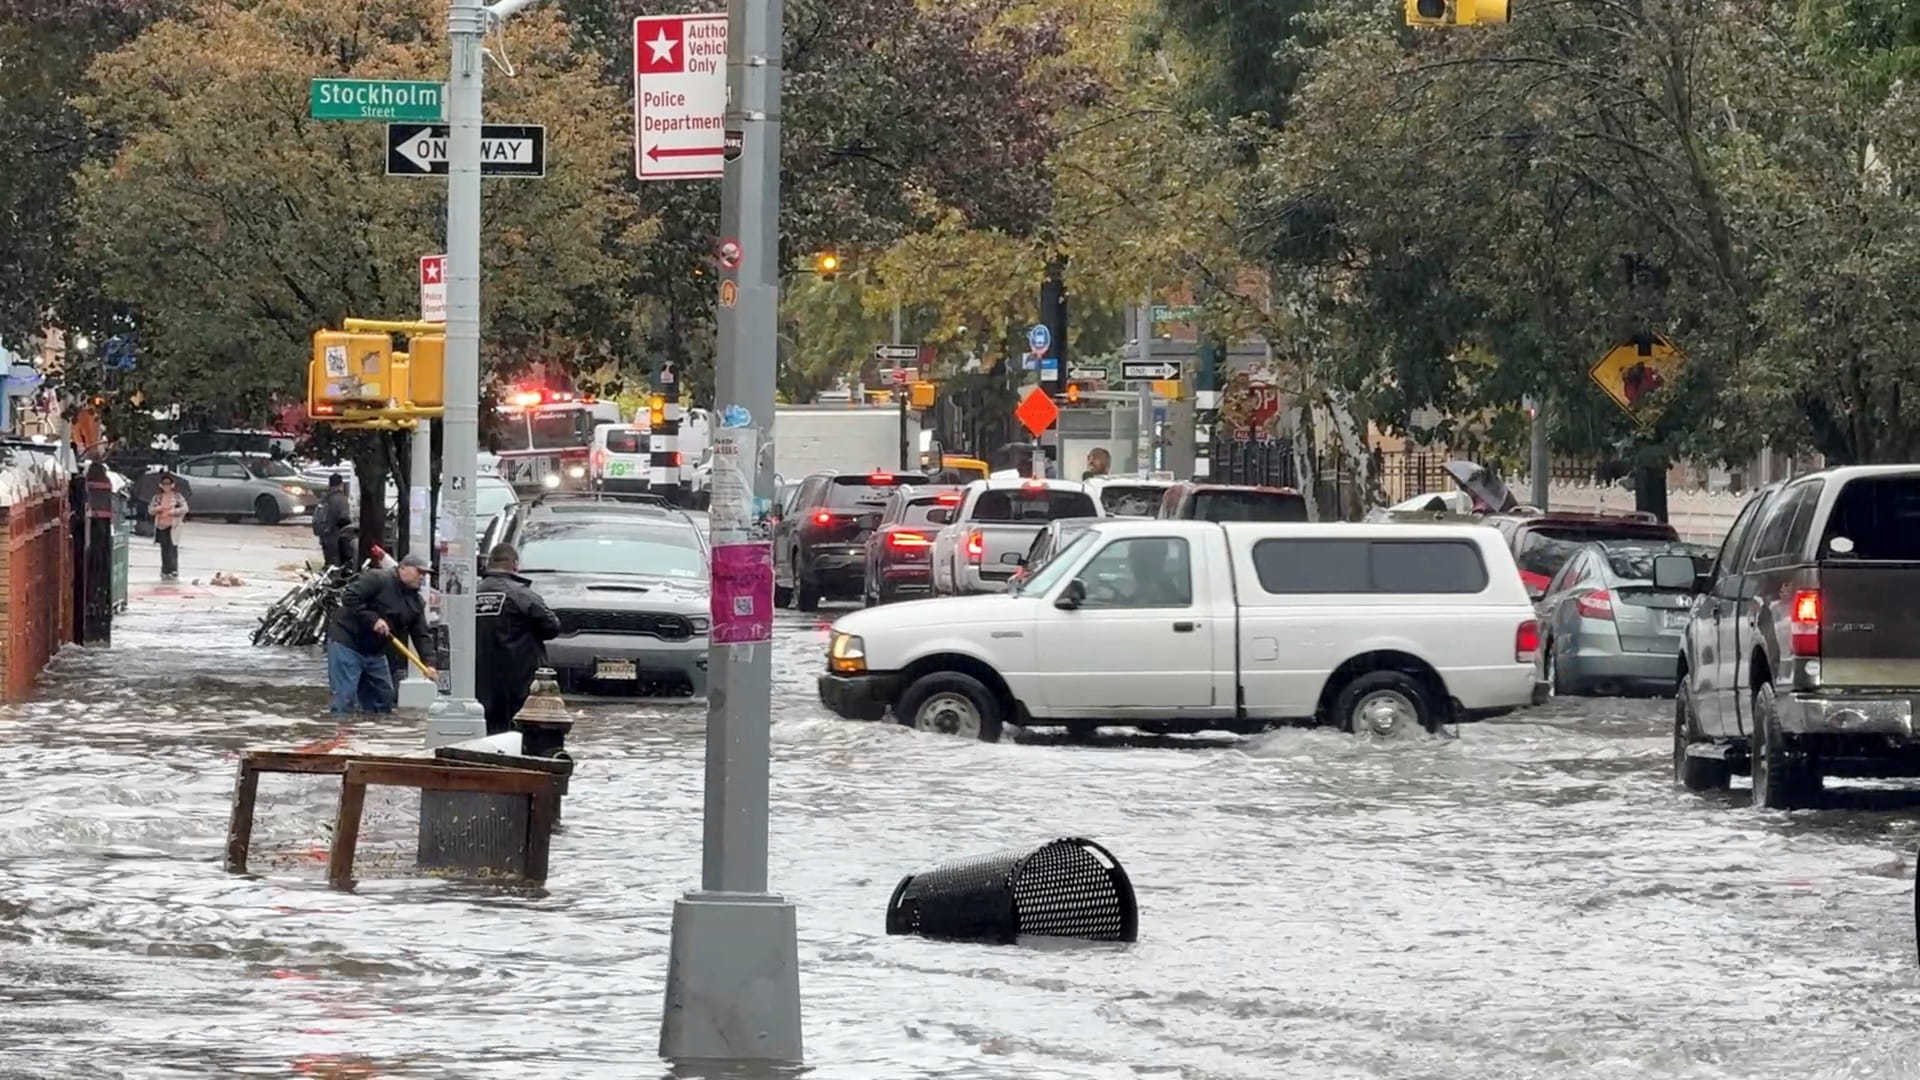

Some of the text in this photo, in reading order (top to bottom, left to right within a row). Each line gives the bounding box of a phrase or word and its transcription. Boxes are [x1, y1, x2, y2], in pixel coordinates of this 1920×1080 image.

[688, 24, 727, 38] Autho
[688, 42, 728, 56] Vehicl
[688, 58, 717, 75] Only
[320, 83, 437, 106] Stockholm
[644, 91, 685, 107] Police
[361, 105, 396, 118] Street
[417, 140, 447, 159] ON
